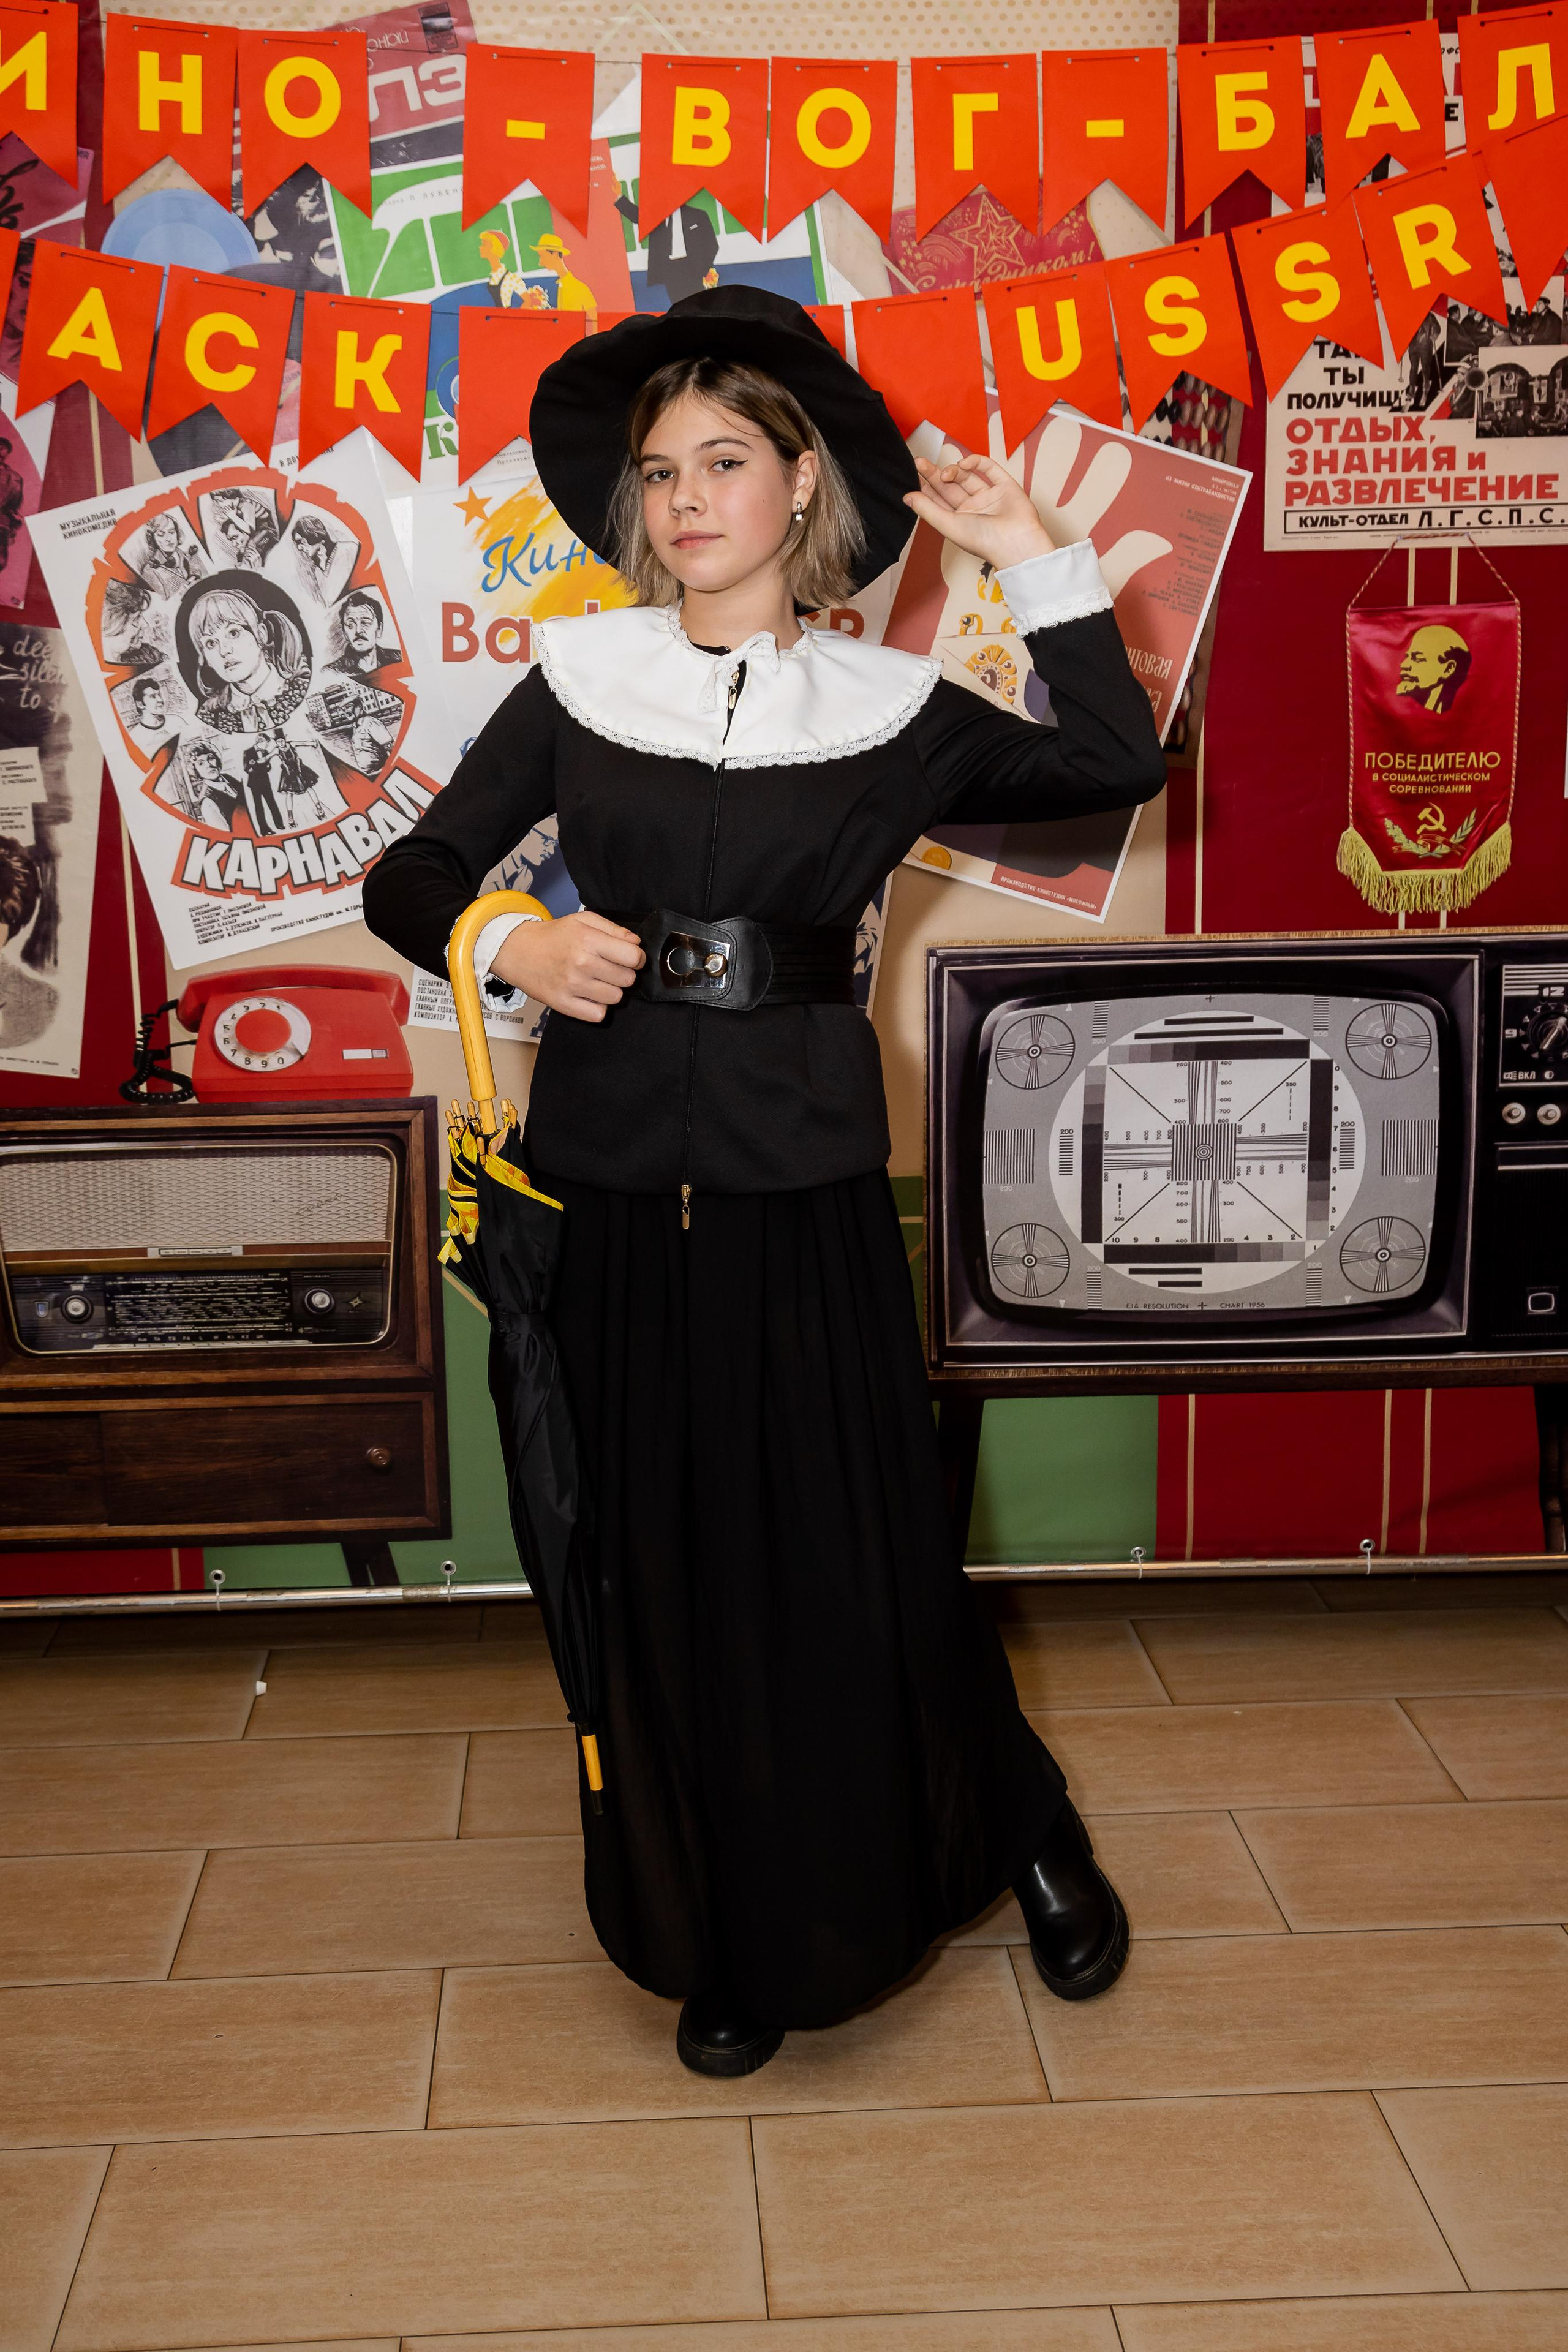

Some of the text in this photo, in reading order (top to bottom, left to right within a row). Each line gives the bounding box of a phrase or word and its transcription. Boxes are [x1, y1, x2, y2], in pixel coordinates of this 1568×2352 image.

[1017, 205, 1471, 380] USSR
[1323, 366, 1365, 385] ТЫ
[1286, 416, 1436, 444] ОТДЫХ,
[1287, 445, 1457, 475] ЗНАНИЯ
[1285, 474, 1559, 507] РАЗВЛЕЧЕНИЕ
[59, 508, 116, 530] МУЗЫКАЛЬНАЯ
[1299, 513, 1408, 527] КУЛЬТ-ОТДЕЛ
[1365, 751, 1501, 772] ПОБЕДИТЕЛЮ
[1373, 772, 1490, 783] В СОЦИАЛИСТИЧЕСКОМ
[1389, 785, 1471, 794] СОРЕВНОВАНИИ
[181, 766, 438, 896] КАРНАВАЛ
[1001, 876, 1036, 891] ПРОИЗВОДСТВО
[1037, 888, 1066, 900] КИНОСТУДИИ
[417, 987, 447, 996] ПОСТАНОВКА
[418, 979, 443, 987] СЦЕНАРИЙ
[416, 995, 439, 1003] ГЛАВНЫЙ
[414, 1011, 446, 1020] КОМПОЗИТОР
